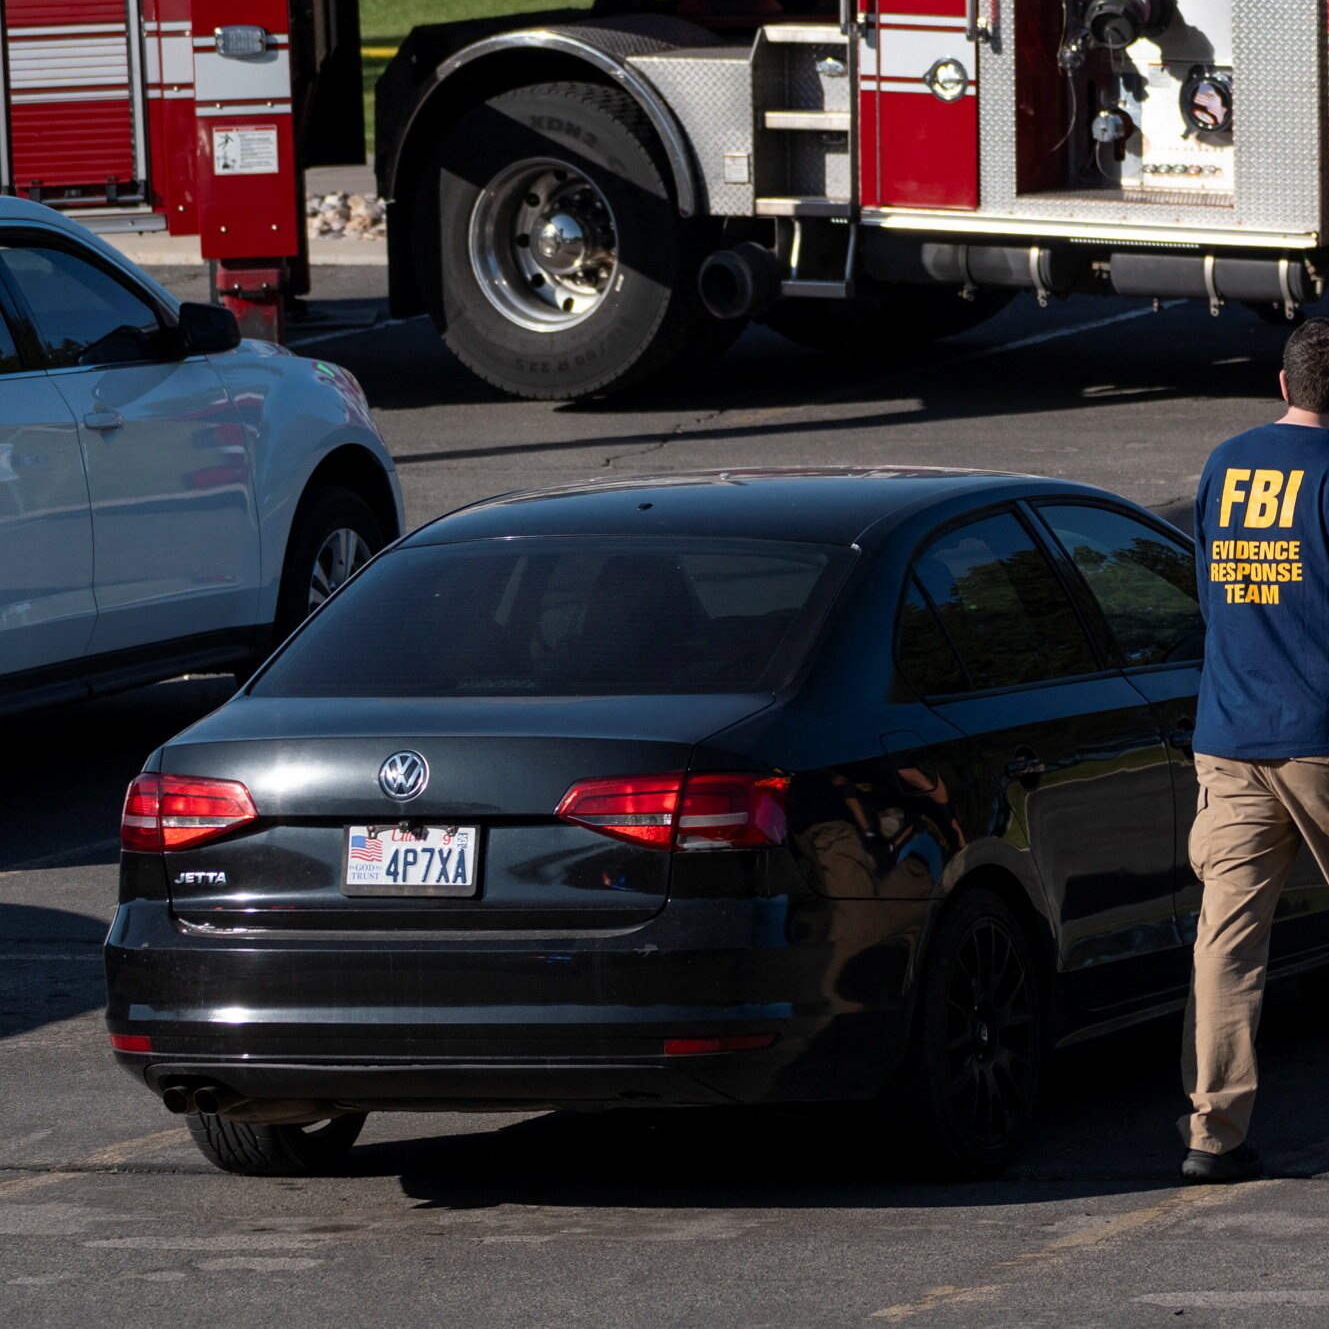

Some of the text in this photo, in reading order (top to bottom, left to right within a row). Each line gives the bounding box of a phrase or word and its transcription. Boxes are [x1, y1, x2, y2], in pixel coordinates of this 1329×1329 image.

[1219, 467, 1305, 529] FBI
[1211, 539, 1301, 561] EVIDENCE
[1210, 561, 1303, 583] RESPONSE
[1224, 583, 1280, 605] TEAM
[442, 833, 451, 846] 9
[351, 872, 380, 880] TRUST
[355, 863, 375, 872] GOD
[385, 848, 467, 884] 4P7XA
[174, 871, 227, 884] JETTA
